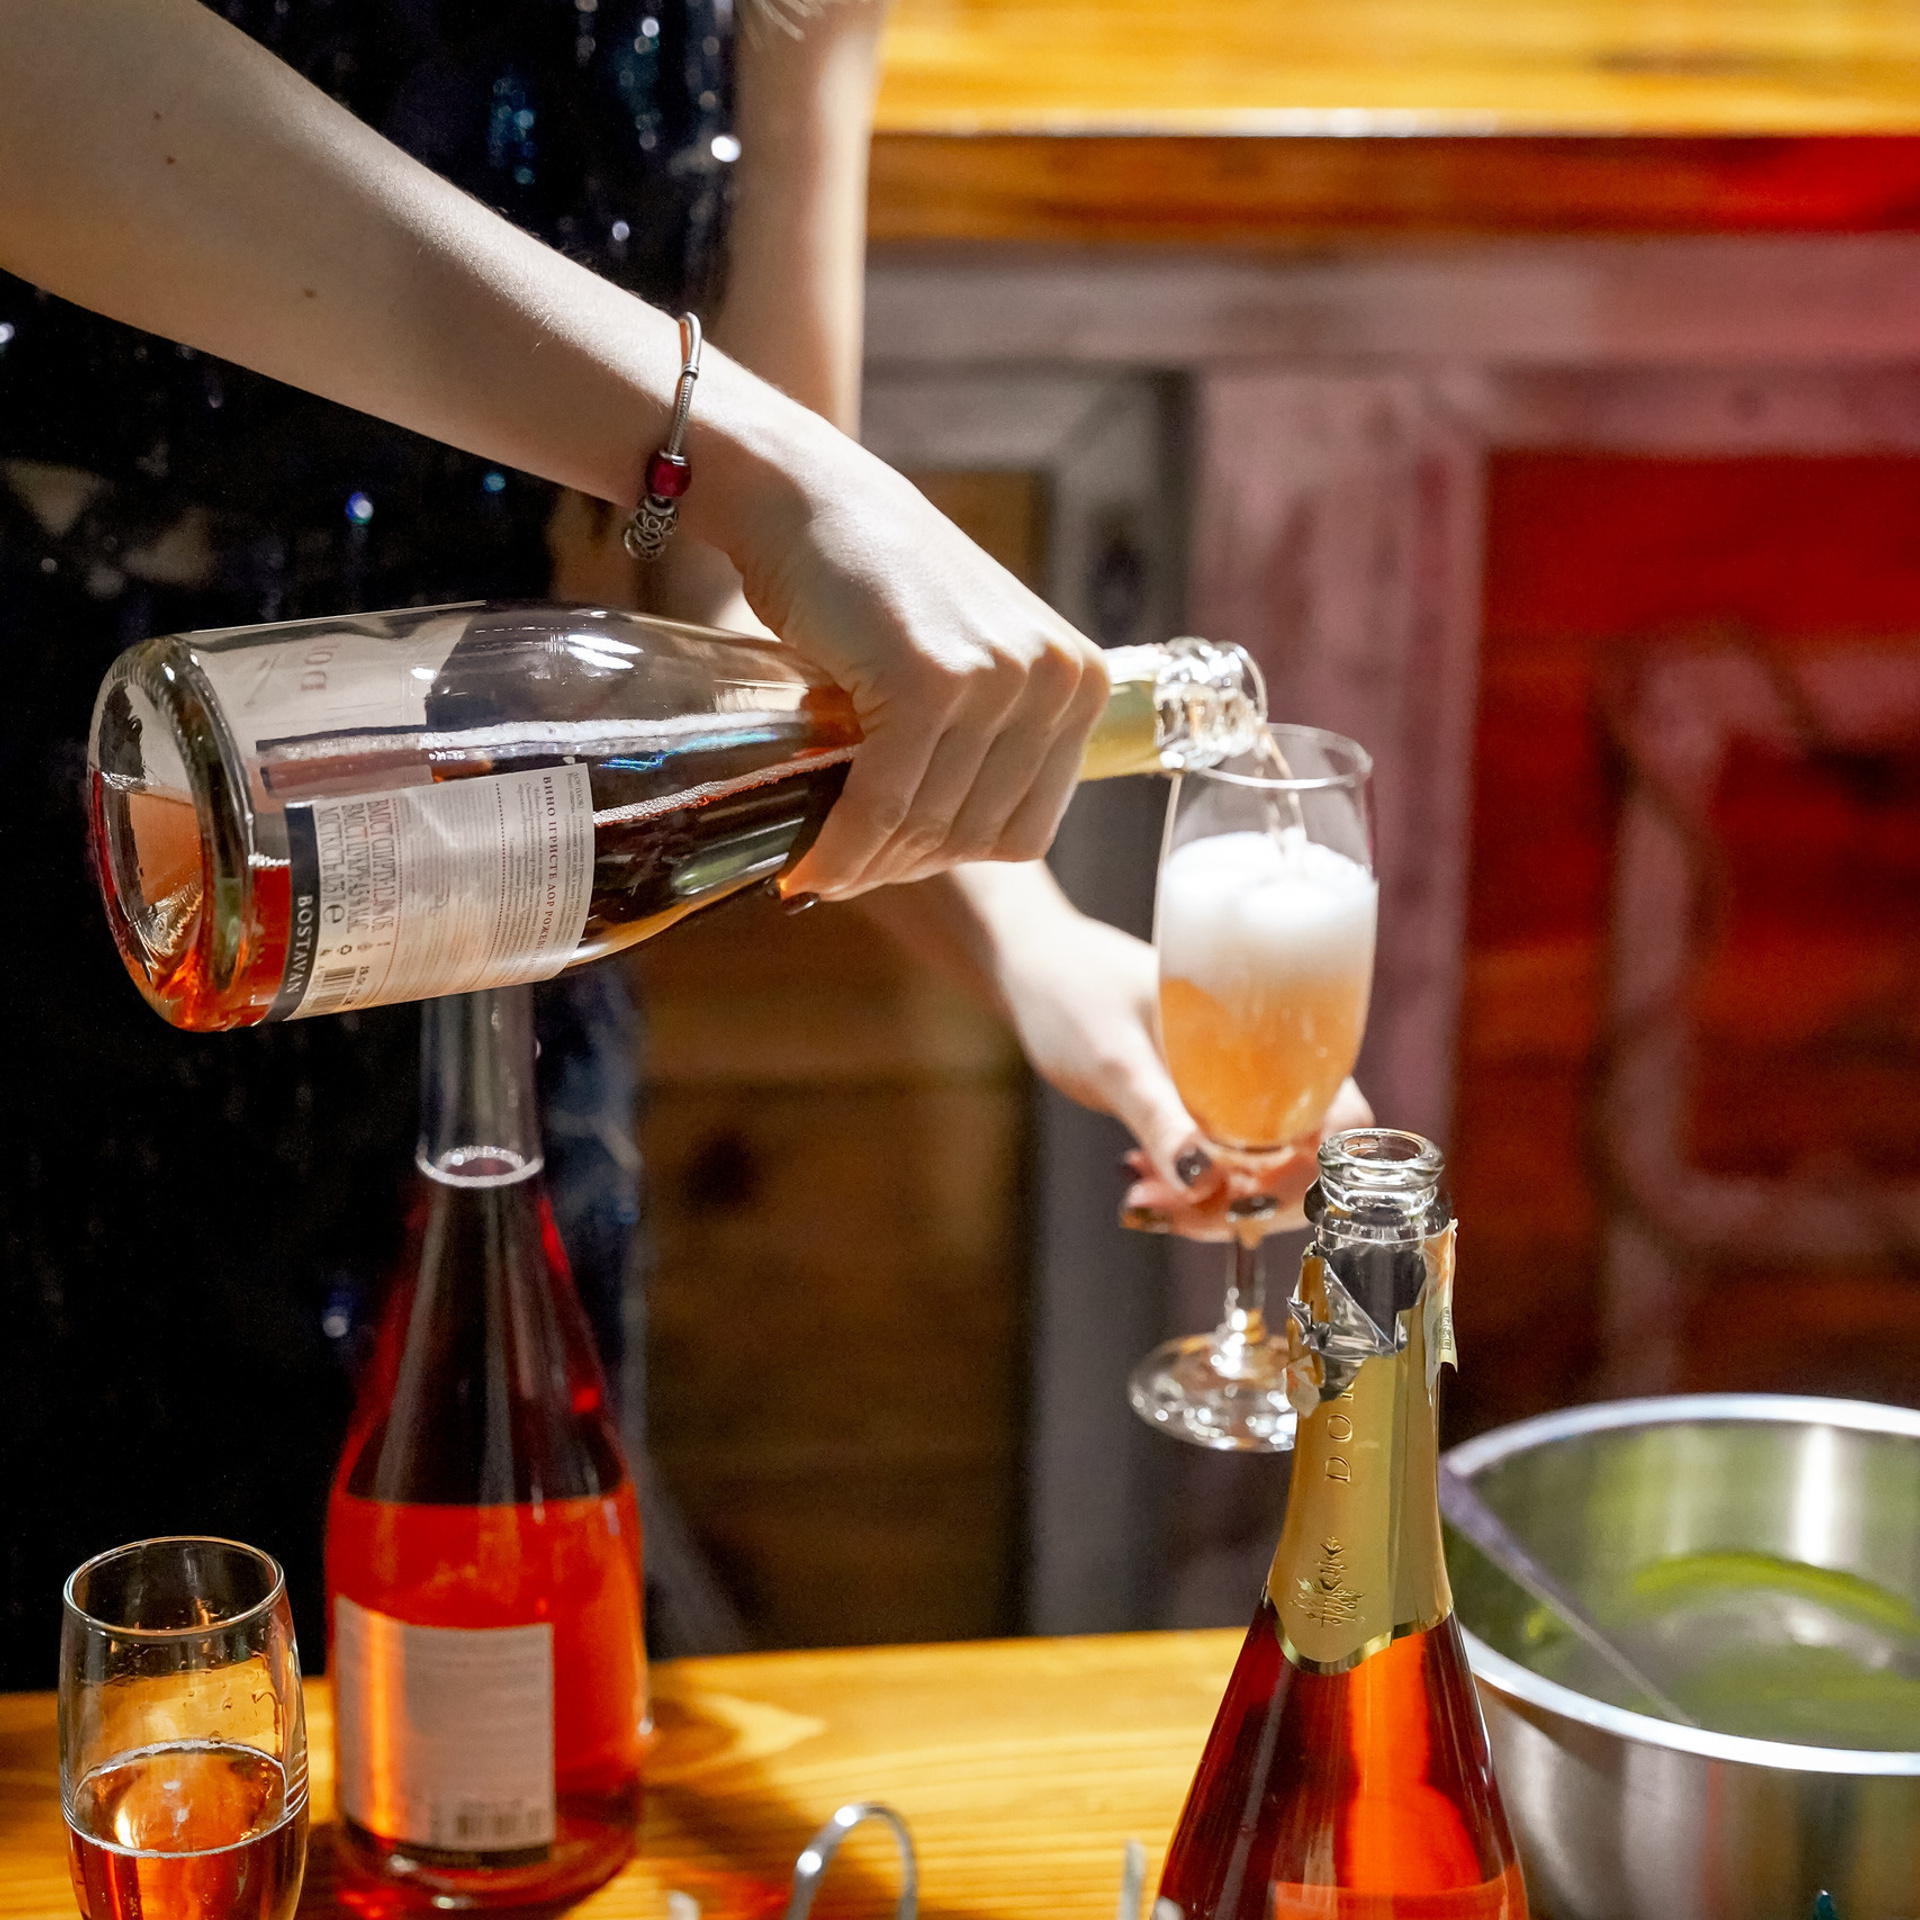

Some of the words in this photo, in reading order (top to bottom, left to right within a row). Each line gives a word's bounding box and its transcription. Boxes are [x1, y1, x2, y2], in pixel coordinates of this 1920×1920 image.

[543, 776, 556, 817] ВИНО
[546, 884, 556, 907] ДОР
[286, 896, 313, 994] BOSTAVAN
